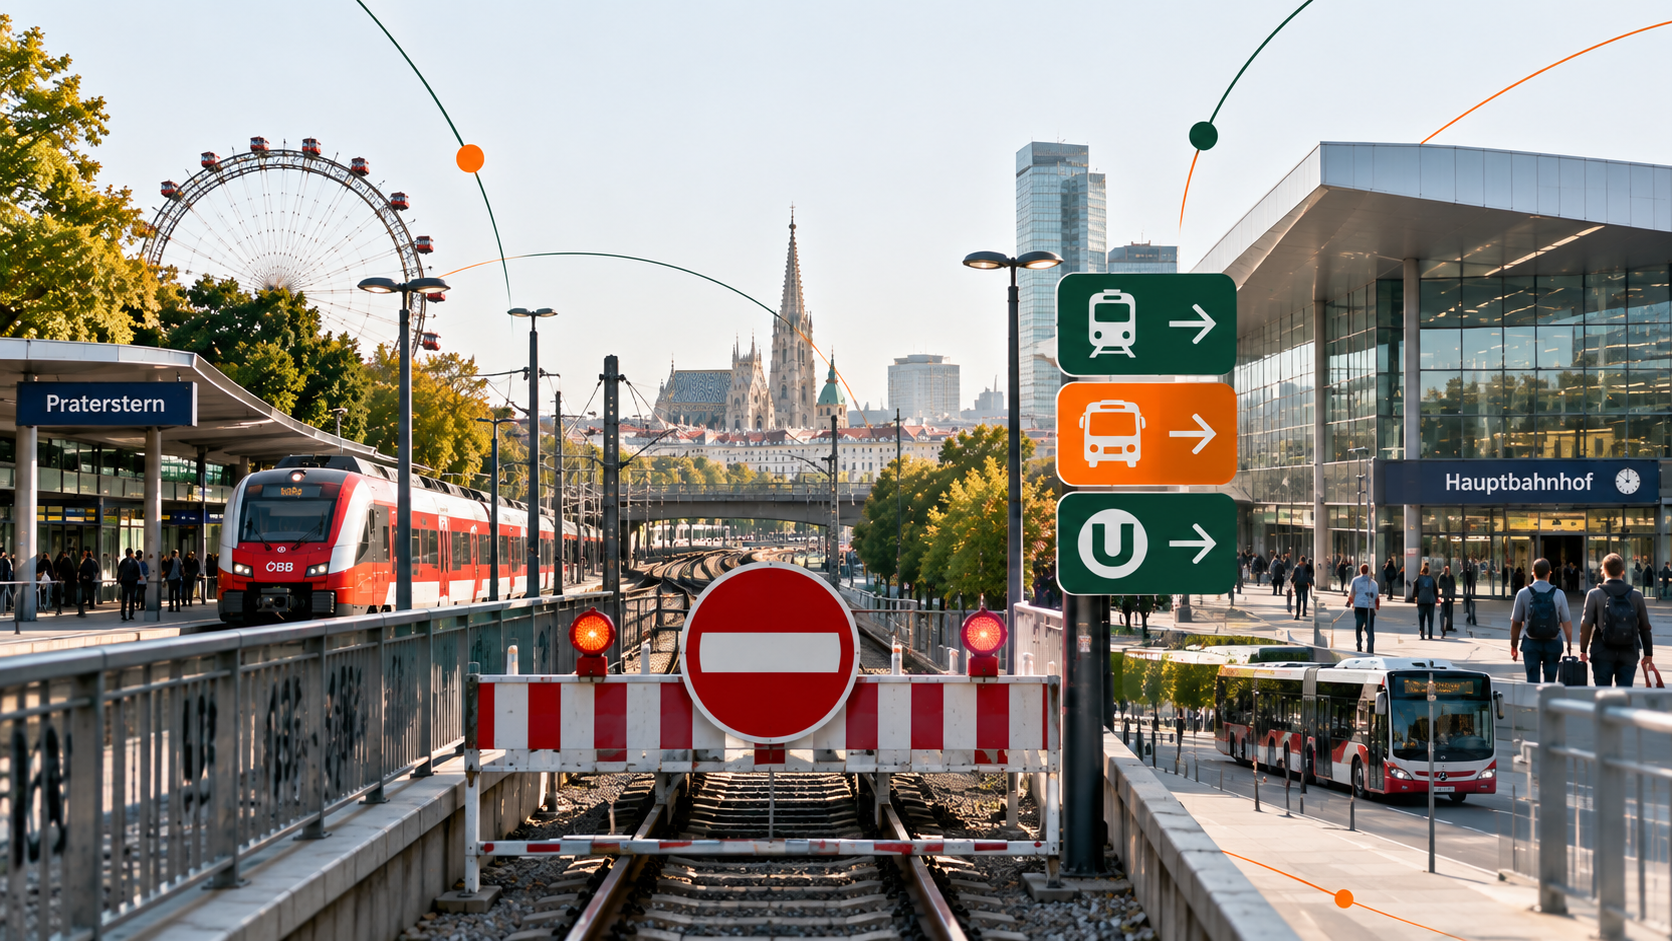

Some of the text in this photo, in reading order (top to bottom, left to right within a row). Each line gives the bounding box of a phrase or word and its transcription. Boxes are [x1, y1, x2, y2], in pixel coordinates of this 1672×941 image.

[46, 394, 165, 413] Praterstern
[1446, 472, 1594, 496] Hauptbahnhof
[1092, 523, 1135, 567] U
